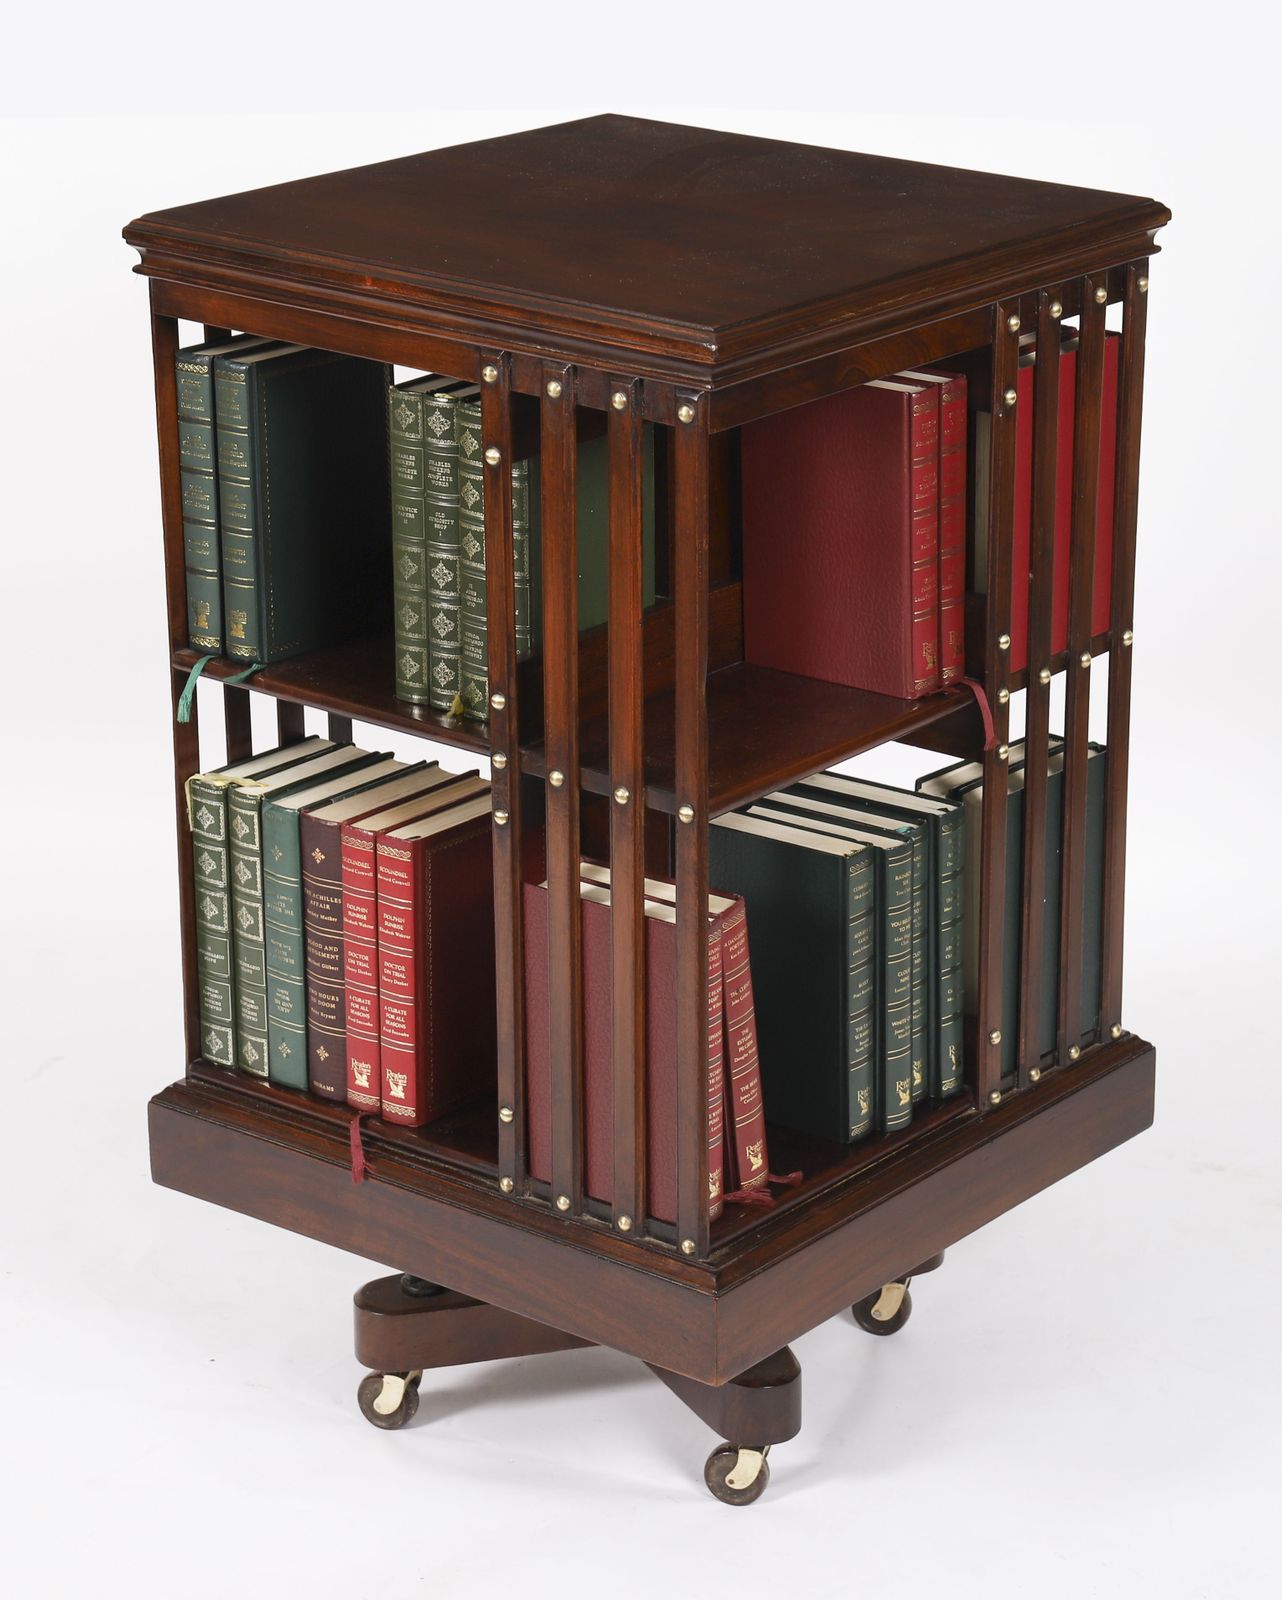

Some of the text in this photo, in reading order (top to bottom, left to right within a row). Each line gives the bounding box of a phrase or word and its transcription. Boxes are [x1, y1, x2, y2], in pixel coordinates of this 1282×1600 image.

[428, 460, 450, 468] CHARLES
[428, 466, 450, 474] DICKENS
[428, 474, 453, 482] COMPLETE
[432, 480, 449, 488] WORKS
[428, 516, 454, 526] CURIOSITY
[342, 856, 371, 869] SCOUNDREL
[379, 866, 408, 878] SCOUNDREL
[392, 878, 410, 886] Cornwell
[312, 891, 342, 904] ACHILLES
[310, 900, 330, 910] AFFAIR
[346, 904, 368, 914] DOLPHIN
[320, 914, 338, 922] Mather
[348, 911, 367, 920] SUNRISE
[384, 914, 405, 924] DOLPHIN
[384, 921, 404, 930] SUNRISE
[348, 951, 369, 961] DOCTOR
[322, 964, 338, 972] Gilbert
[348, 958, 370, 968] ON TRIAL
[384, 961, 406, 972] DOCTOR
[384, 968, 406, 979] ON TRIAL
[318, 992, 340, 1002] HOURS
[352, 996, 371, 1006] CURATE
[318, 1000, 336, 1010] DOOM
[350, 1002, 369, 1012] FOR ALL
[320, 1012, 336, 1020] Bryant
[350, 1009, 370, 1019] SEASONS
[388, 1006, 407, 1016] CURATE
[386, 1020, 406, 1030] SEASONS
[740, 1084, 750, 1093] THE
